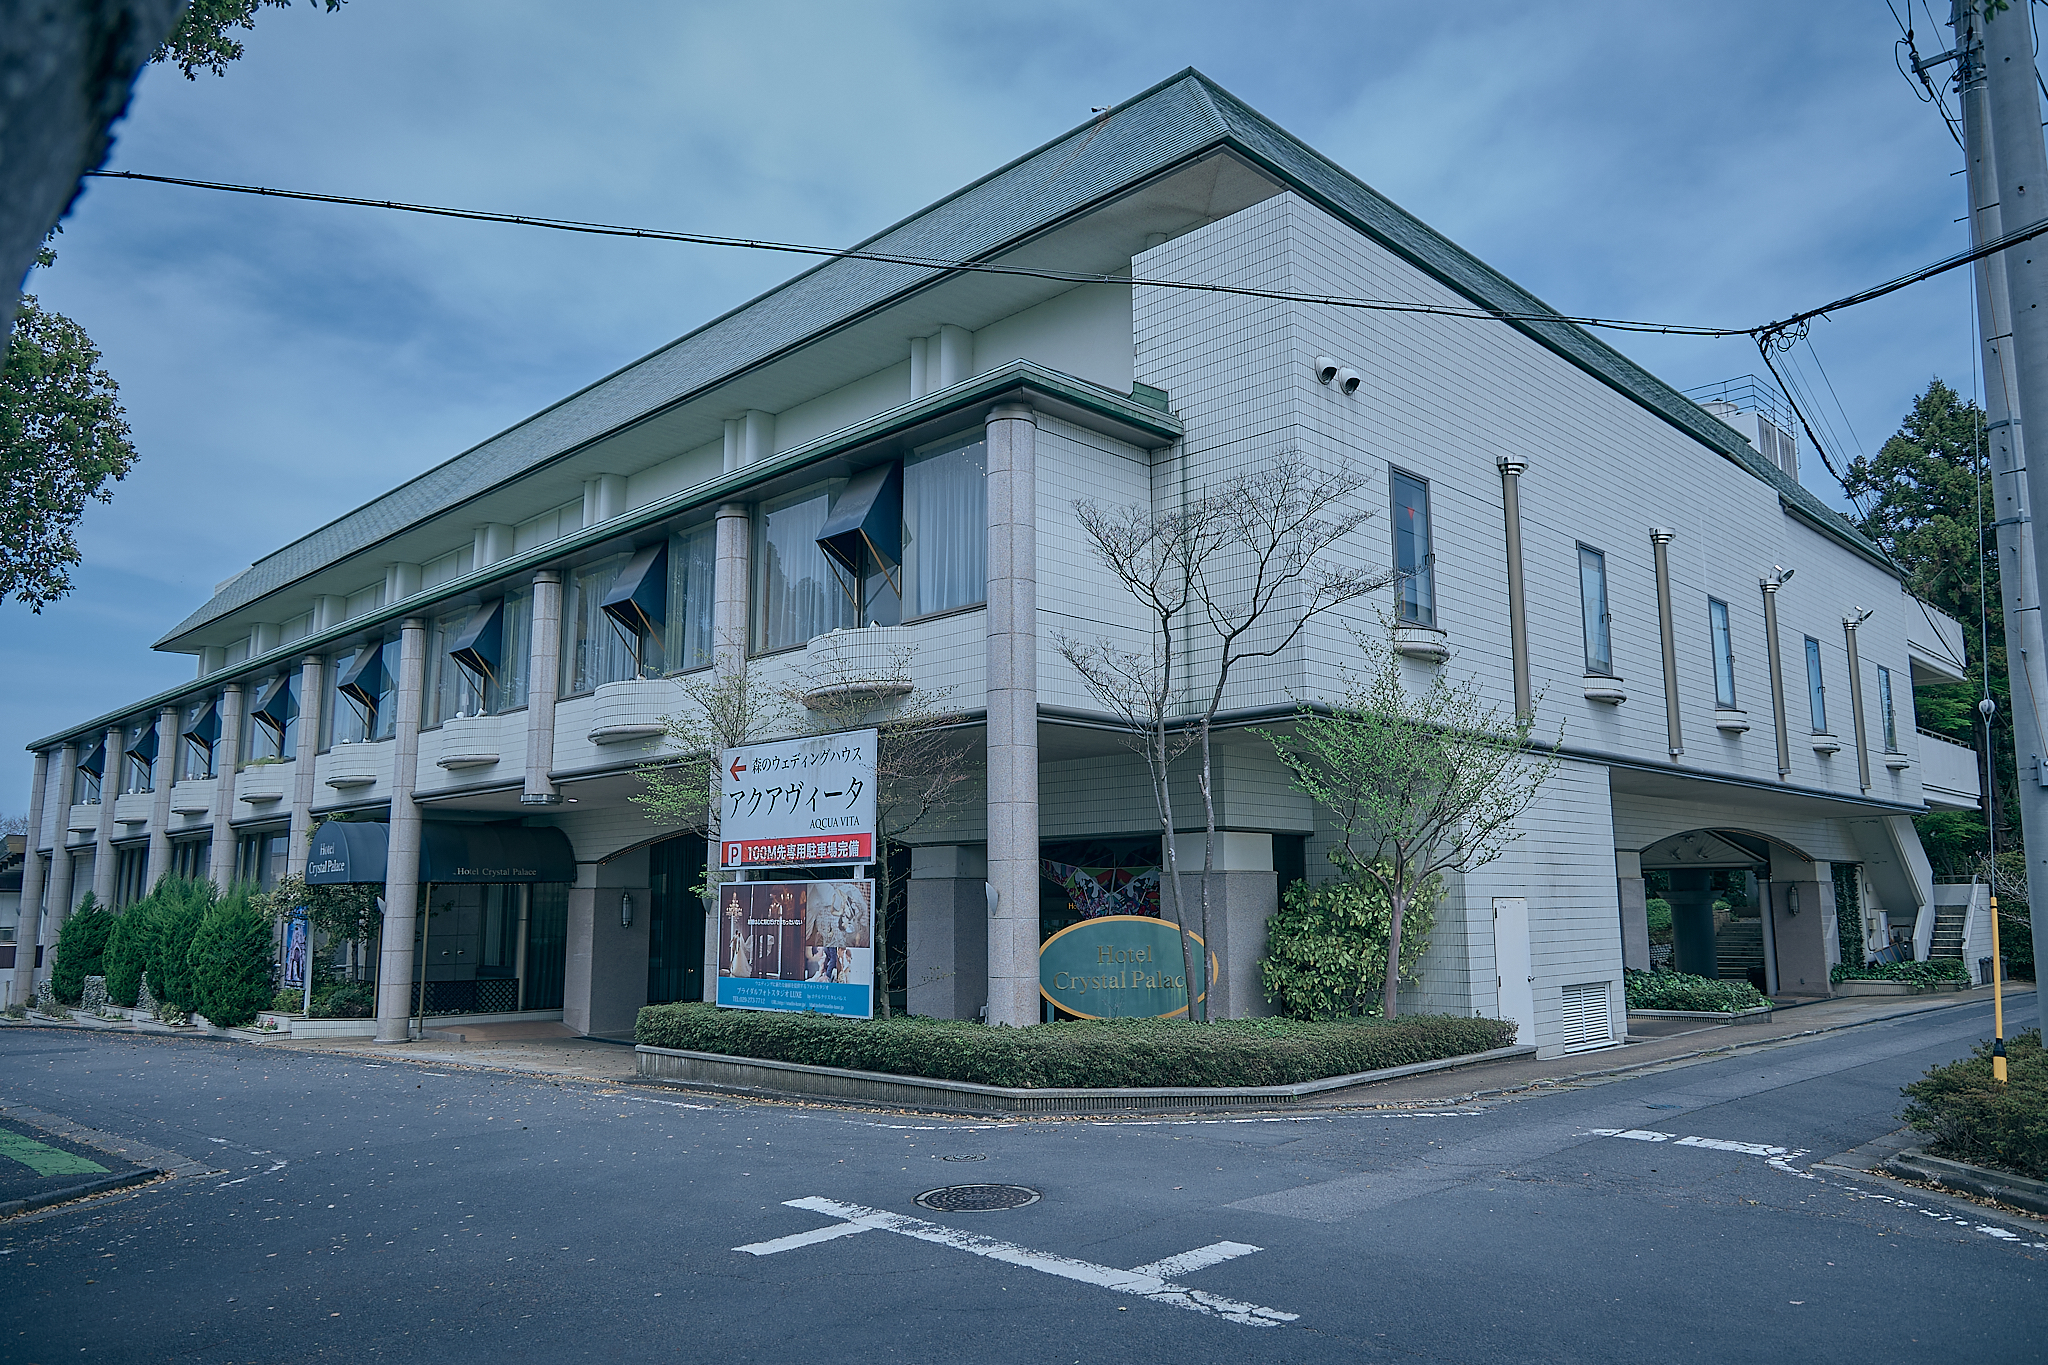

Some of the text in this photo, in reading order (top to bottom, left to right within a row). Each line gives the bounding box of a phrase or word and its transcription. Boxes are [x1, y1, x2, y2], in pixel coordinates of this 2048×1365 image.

[752, 746, 862, 774] 森のウェディングハウス
[729, 777, 863, 818] アクアヴィータ
[809, 816, 860, 830] AQCUA VITA
[320, 842, 335, 855] Hotel
[731, 840, 860, 863] P 100M先専用駐車場完備
[309, 859, 345, 877] Crystal Palace
[457, 867, 537, 877] Hotel Crystal Palace
[1096, 945, 1153, 964] Hotel
[1053, 971, 1185, 994] Crystal Palac
